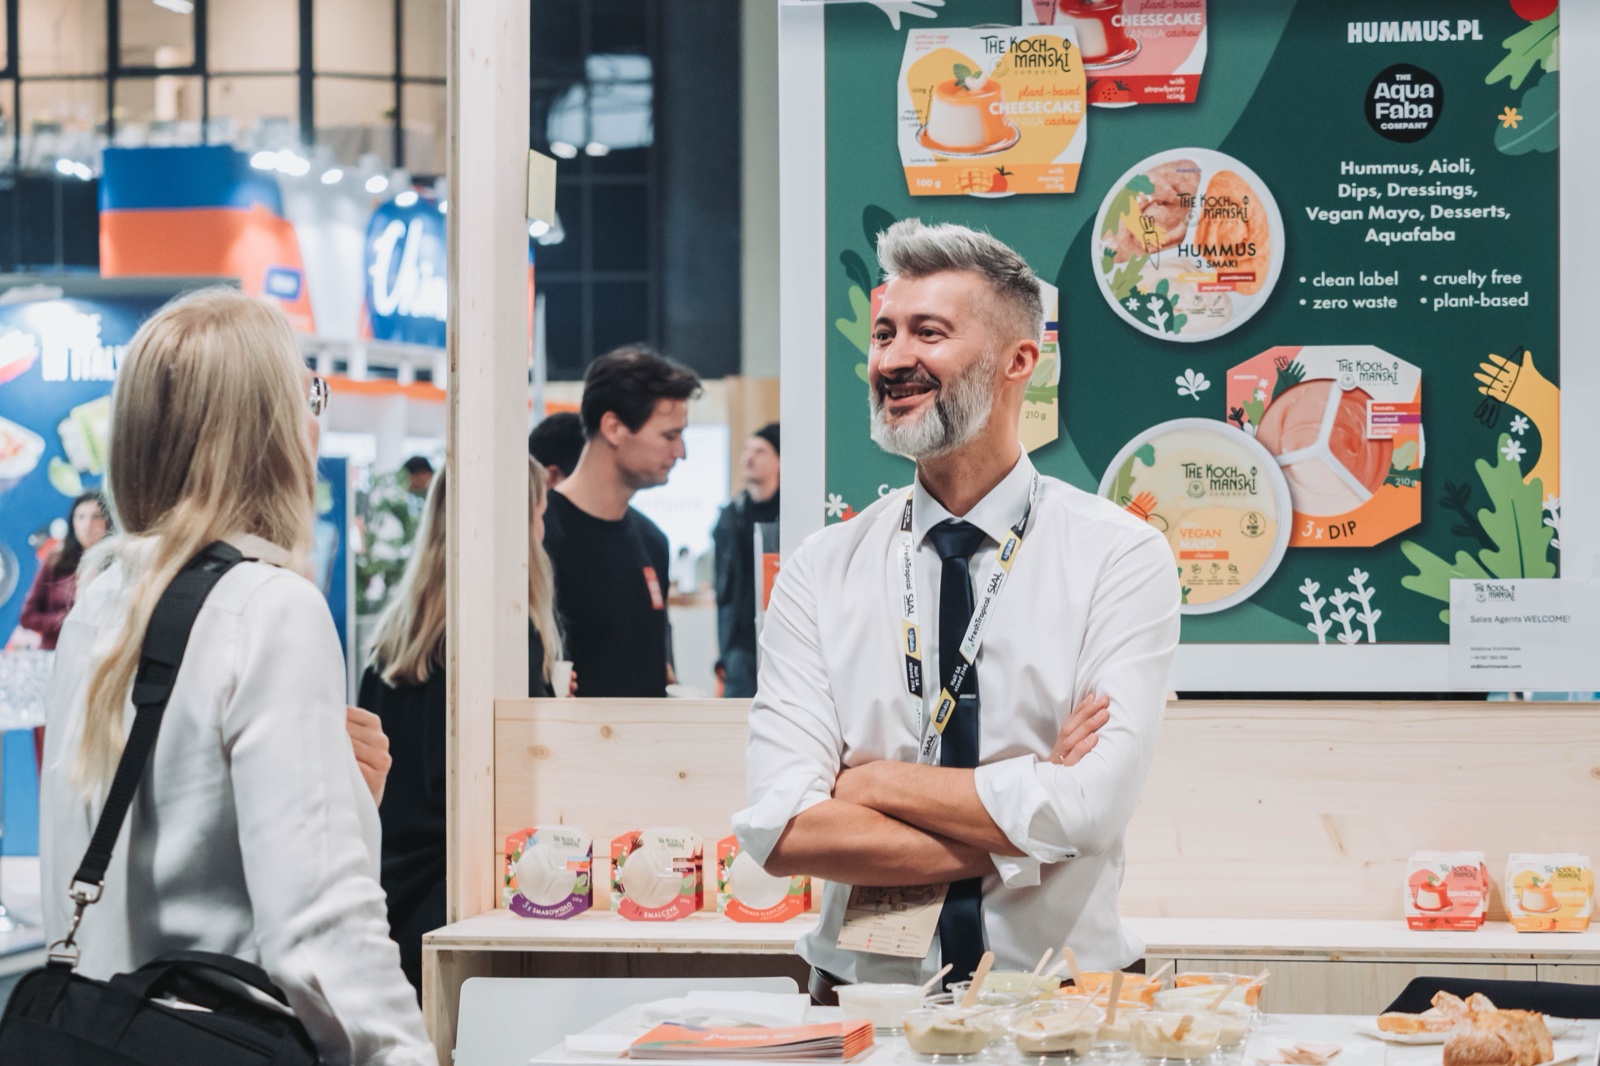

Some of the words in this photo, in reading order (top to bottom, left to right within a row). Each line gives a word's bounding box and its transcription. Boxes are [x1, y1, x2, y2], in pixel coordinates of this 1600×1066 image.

[1111, 13, 1201, 27] CHEESECAKE
[1166, 28, 1199, 38] cashew
[1347, 20, 1483, 43] HUMMUS.PL
[980, 35, 1006, 54] THE
[1010, 36, 1047, 53] KOCH
[1014, 47, 1071, 73] MANSKI
[1018, 85, 1080, 101] plant-based
[1144, 85, 1185, 94] strawberry
[1166, 93, 1185, 101] icing
[1374, 82, 1434, 102] Aqua
[989, 100, 1081, 114] CHEESECAKE
[1375, 101, 1433, 119] Faba
[1044, 116, 1080, 126] cashew
[1380, 122, 1428, 130] COMPANY
[1340, 160, 1423, 176] Hummus,
[1429, 158, 1475, 176] Aioli,
[1338, 183, 1382, 201] Dips,
[1387, 181, 1478, 199] Dressings,
[1176, 193, 1196, 208] THE
[1200, 194, 1230, 207] KOCH
[1204, 203, 1249, 223] MANSKI
[1305, 206, 1363, 224] Vegan
[1368, 206, 1425, 223] Mayo,
[1430, 204, 1511, 220] Desserts,
[1365, 226, 1456, 246] Aquafaba
[1178, 243, 1256, 258] HUMMUS
[1195, 260, 1202, 268] 3
[1206, 260, 1238, 268] SMAKI
[1313, 272, 1355, 286] clean
[1359, 271, 1399, 286] label
[1433, 270, 1486, 288] cruelty
[1491, 269, 1522, 285] free
[1313, 297, 1348, 309] zero
[1352, 296, 1398, 309] waste
[1433, 292, 1529, 311] plant-based
[1336, 359, 1353, 372] THE
[1356, 360, 1383, 372] KOCH
[1359, 368, 1398, 385] MANSKI
[1025, 411, 1039, 419] 210
[1041, 412, 1046, 420] g
[1181, 463, 1203, 479] THE
[1206, 464, 1237, 479] KOCH
[1210, 473, 1257, 495] MANSKI
[1395, 477, 1410, 486] 210
[1411, 479, 1418, 487] g
[1179, 528, 1222, 538] VEGAN
[1302, 520, 1314, 537] 3
[1328, 520, 1356, 540] DIP
[1179, 539, 1217, 550] MAYO
[1470, 615, 1492, 623] Sales
[1494, 615, 1522, 624] Agents
[1523, 615, 1570, 623] WELCOME!
